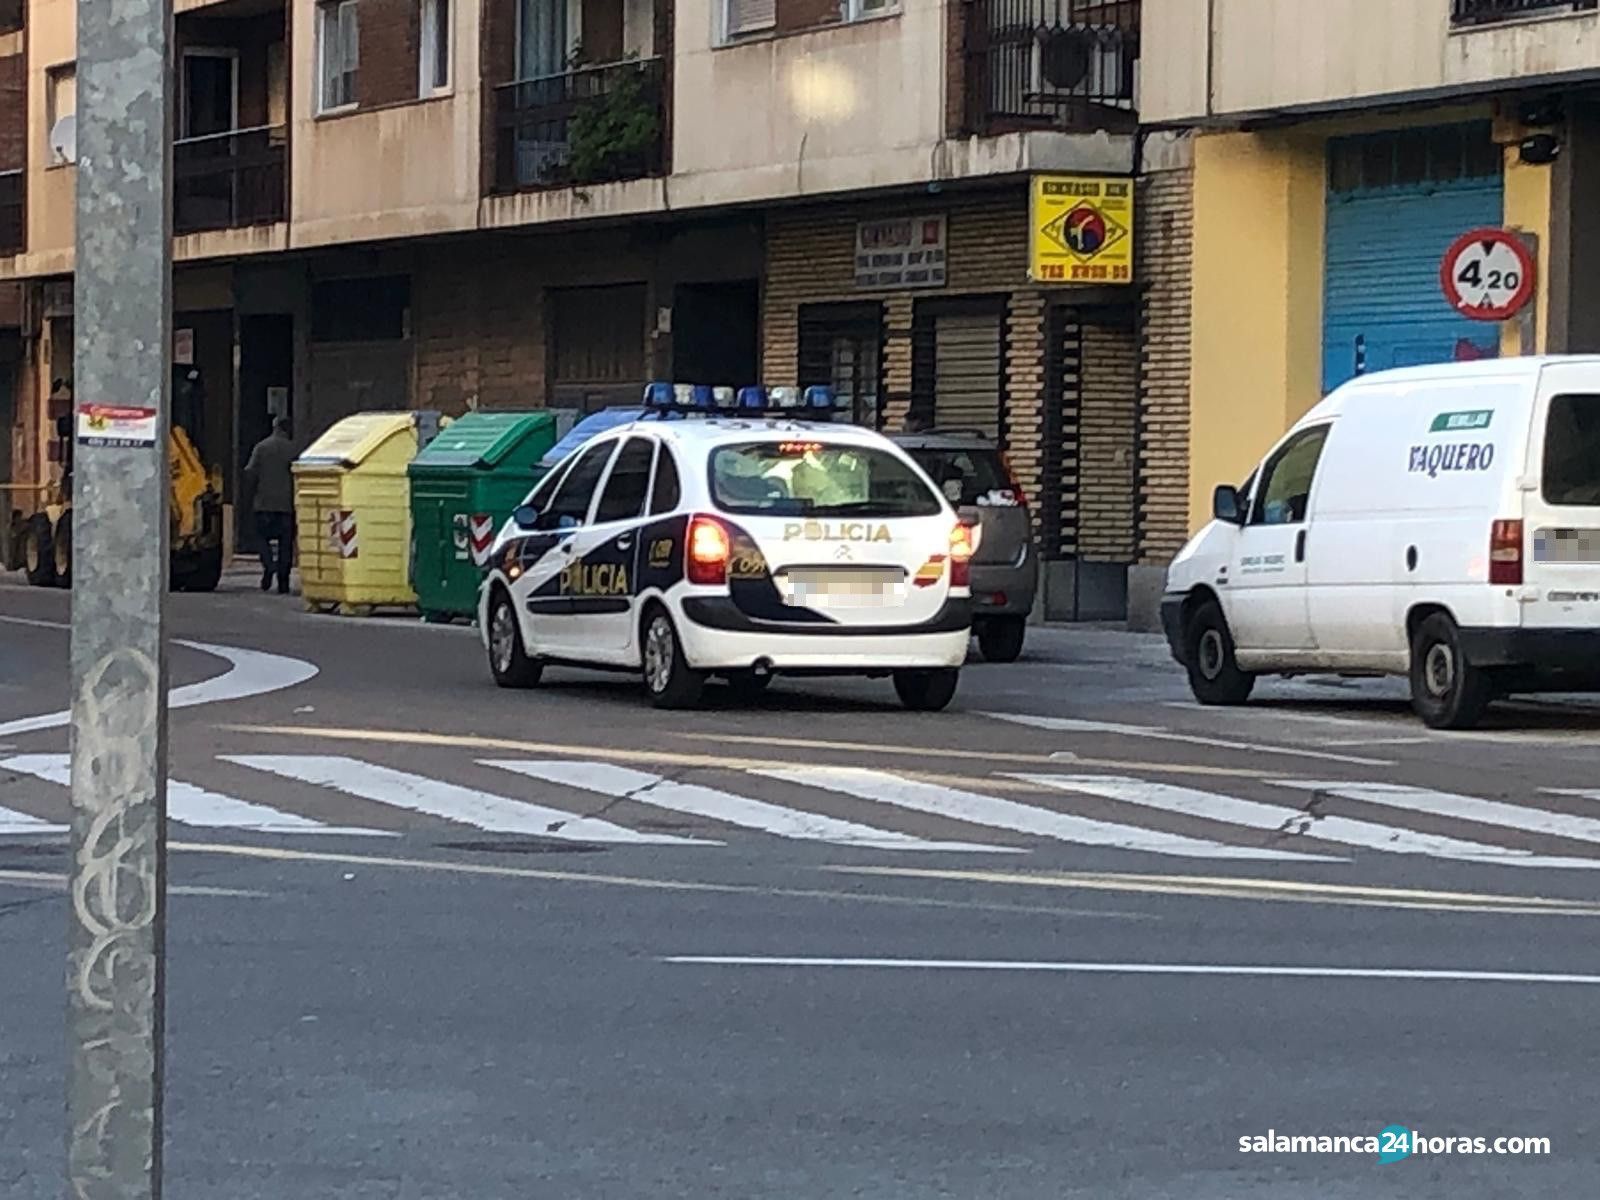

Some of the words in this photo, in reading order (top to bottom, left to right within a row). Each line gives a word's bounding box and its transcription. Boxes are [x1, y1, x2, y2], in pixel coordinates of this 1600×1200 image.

[1409, 443, 1495, 478] VAQUERO
[783, 519, 893, 543] POLICIA
[559, 560, 629, 595] POLICIA
